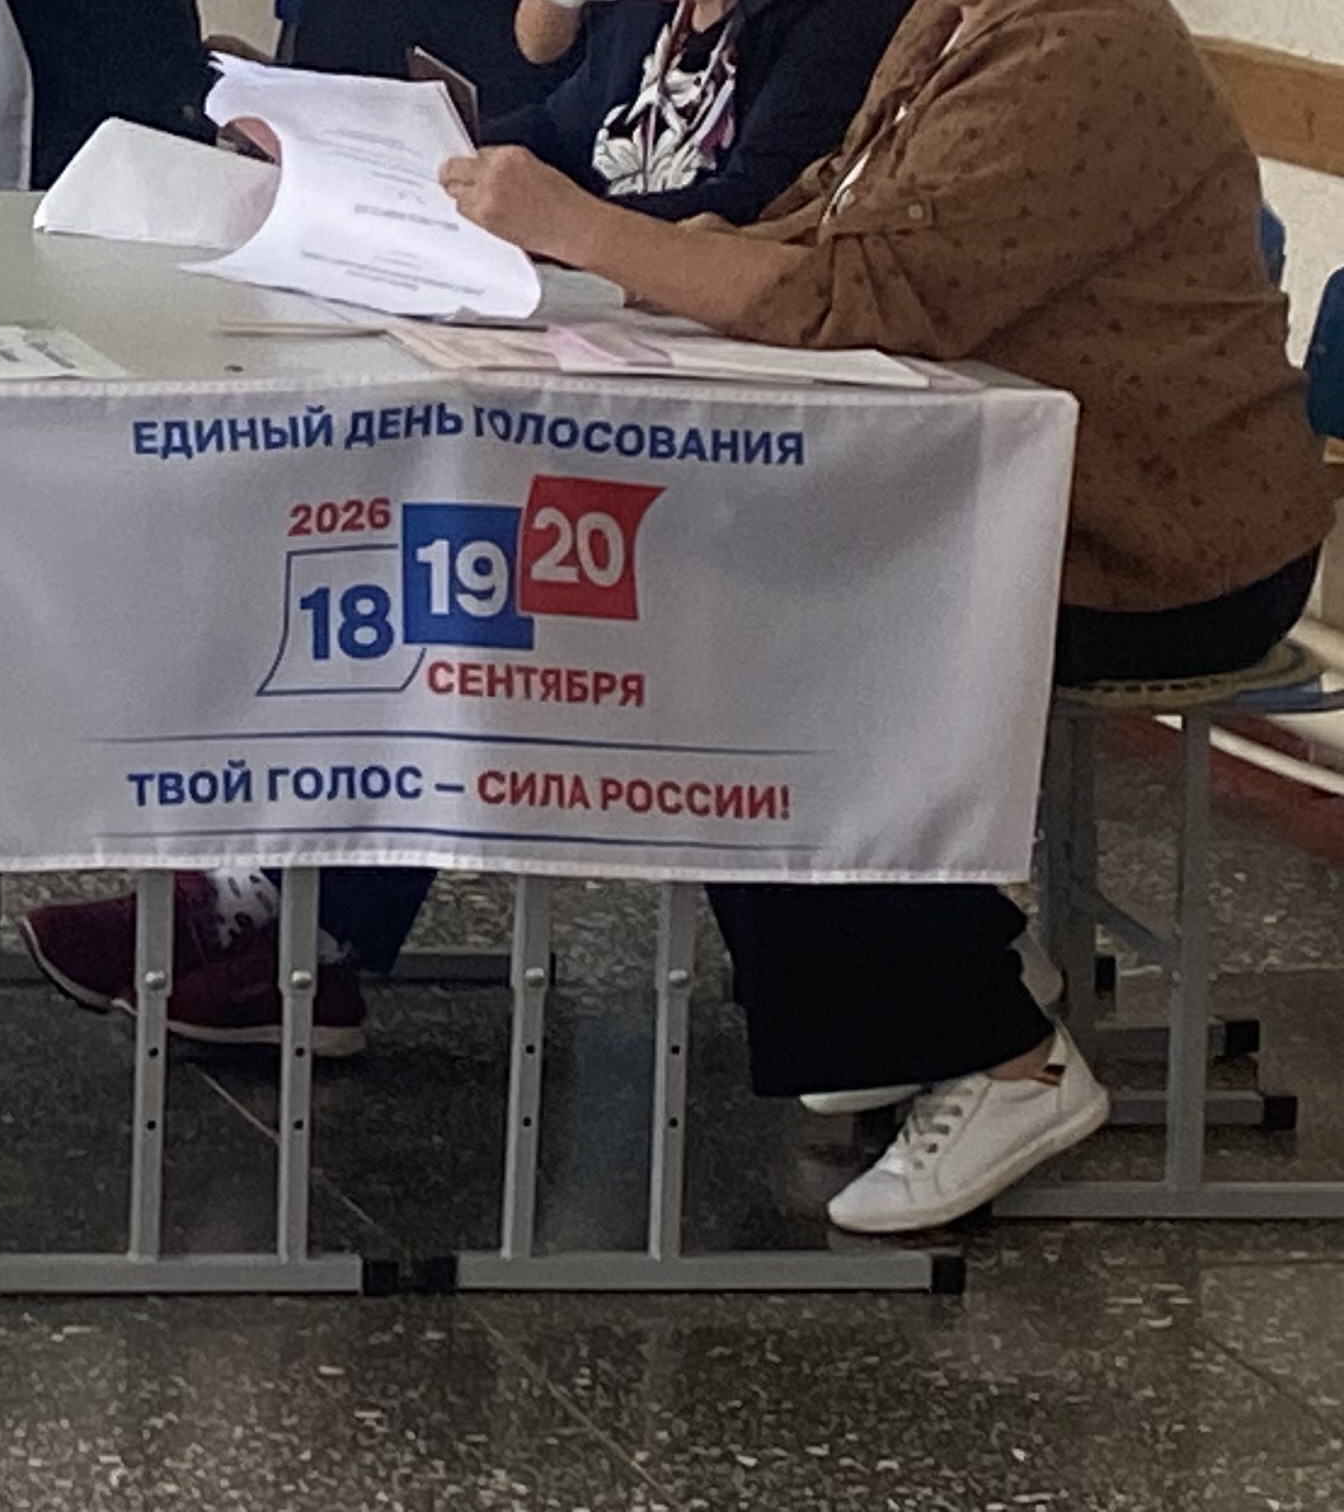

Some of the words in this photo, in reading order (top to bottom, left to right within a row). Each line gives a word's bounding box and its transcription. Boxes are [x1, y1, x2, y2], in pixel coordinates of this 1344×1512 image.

[132, 407, 335, 459] ЕДИНЫЙ
[344, 403, 464, 449] ДЕНЬ
[287, 497, 392, 537] 2026
[299, 584, 395, 661] 18
[416, 538, 510, 618] 19
[530, 506, 625, 586] 20
[426, 661, 646, 707] СЕНТЯБРЯ
[127, 760, 254, 807] ТВОЙ
[268, 765, 424, 801] ГОЛОС
[476, 770, 590, 812] СИЛА
[600, 777, 791, 820] РОССИИ!
